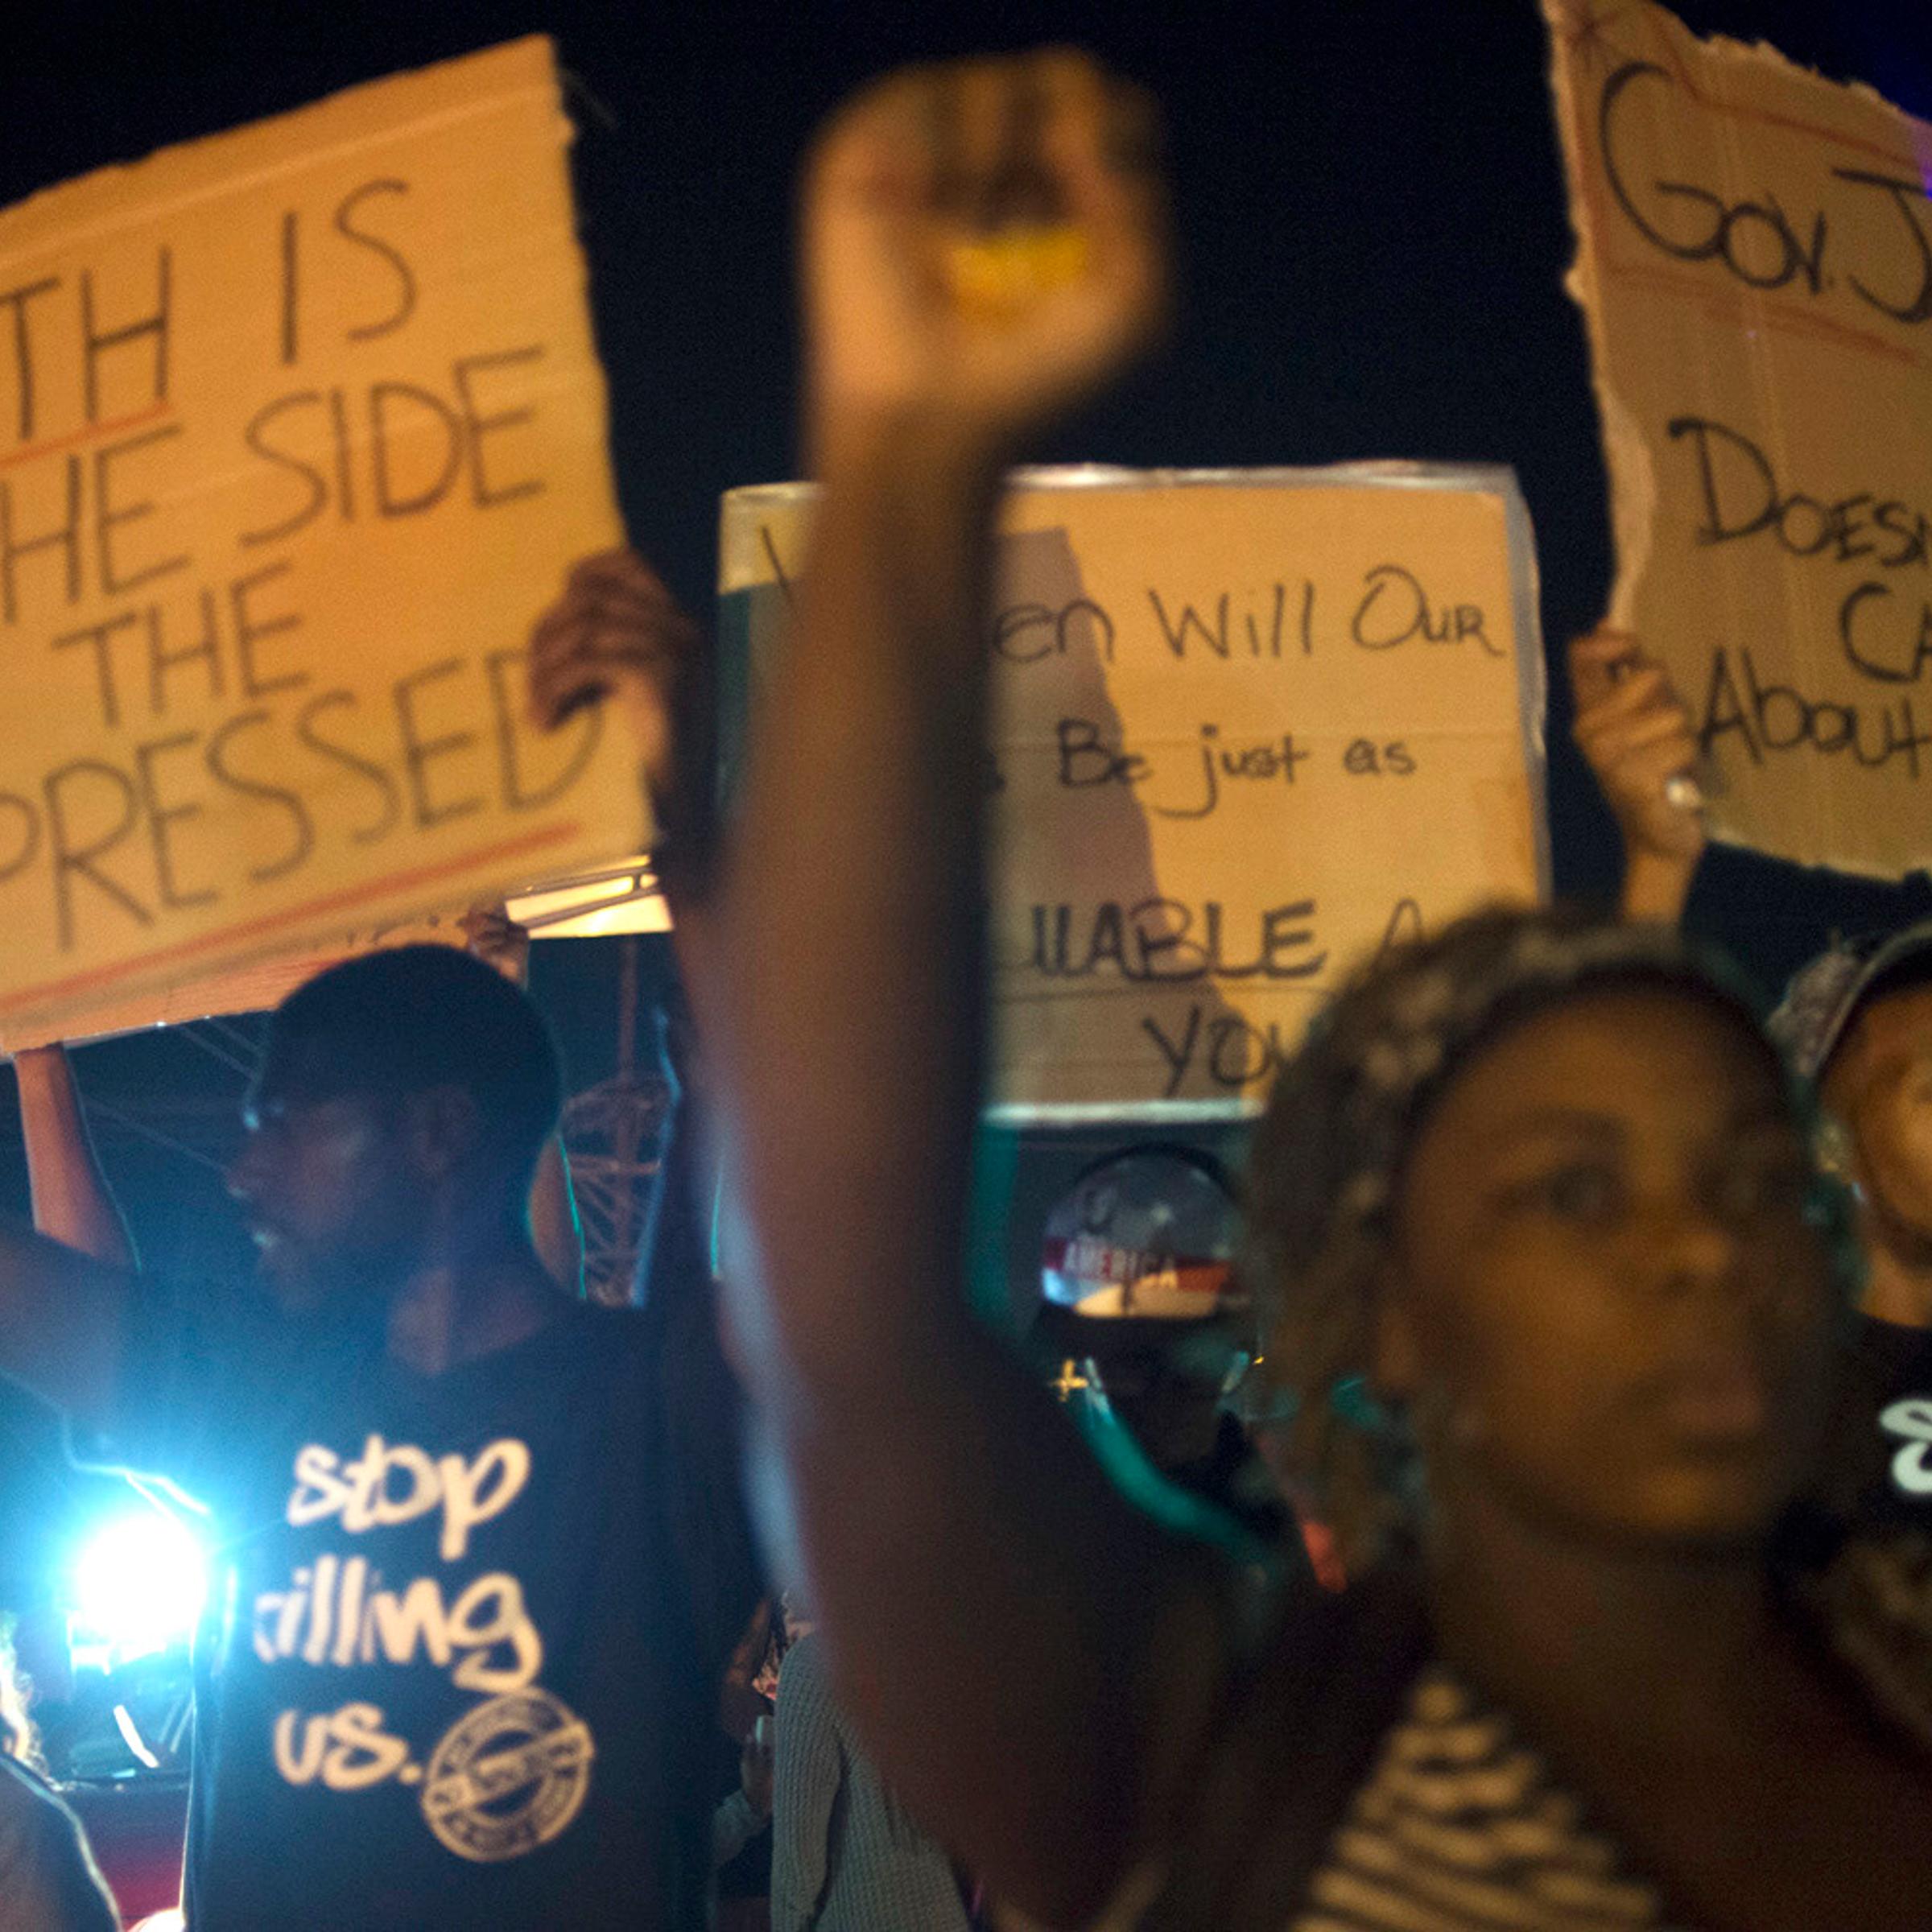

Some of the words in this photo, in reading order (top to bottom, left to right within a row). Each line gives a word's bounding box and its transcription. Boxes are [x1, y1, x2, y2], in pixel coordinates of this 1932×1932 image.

[282, 179, 418, 368] IS
[238, 345, 548, 550] SIDE
[50, 558, 313, 729] THE
[1148, 580, 1315, 660] Will
[1056, 719, 1154, 788] Be
[1151, 723, 1311, 819] just
[1343, 739, 1417, 776] as
[286, 1433, 531, 1560] stop
